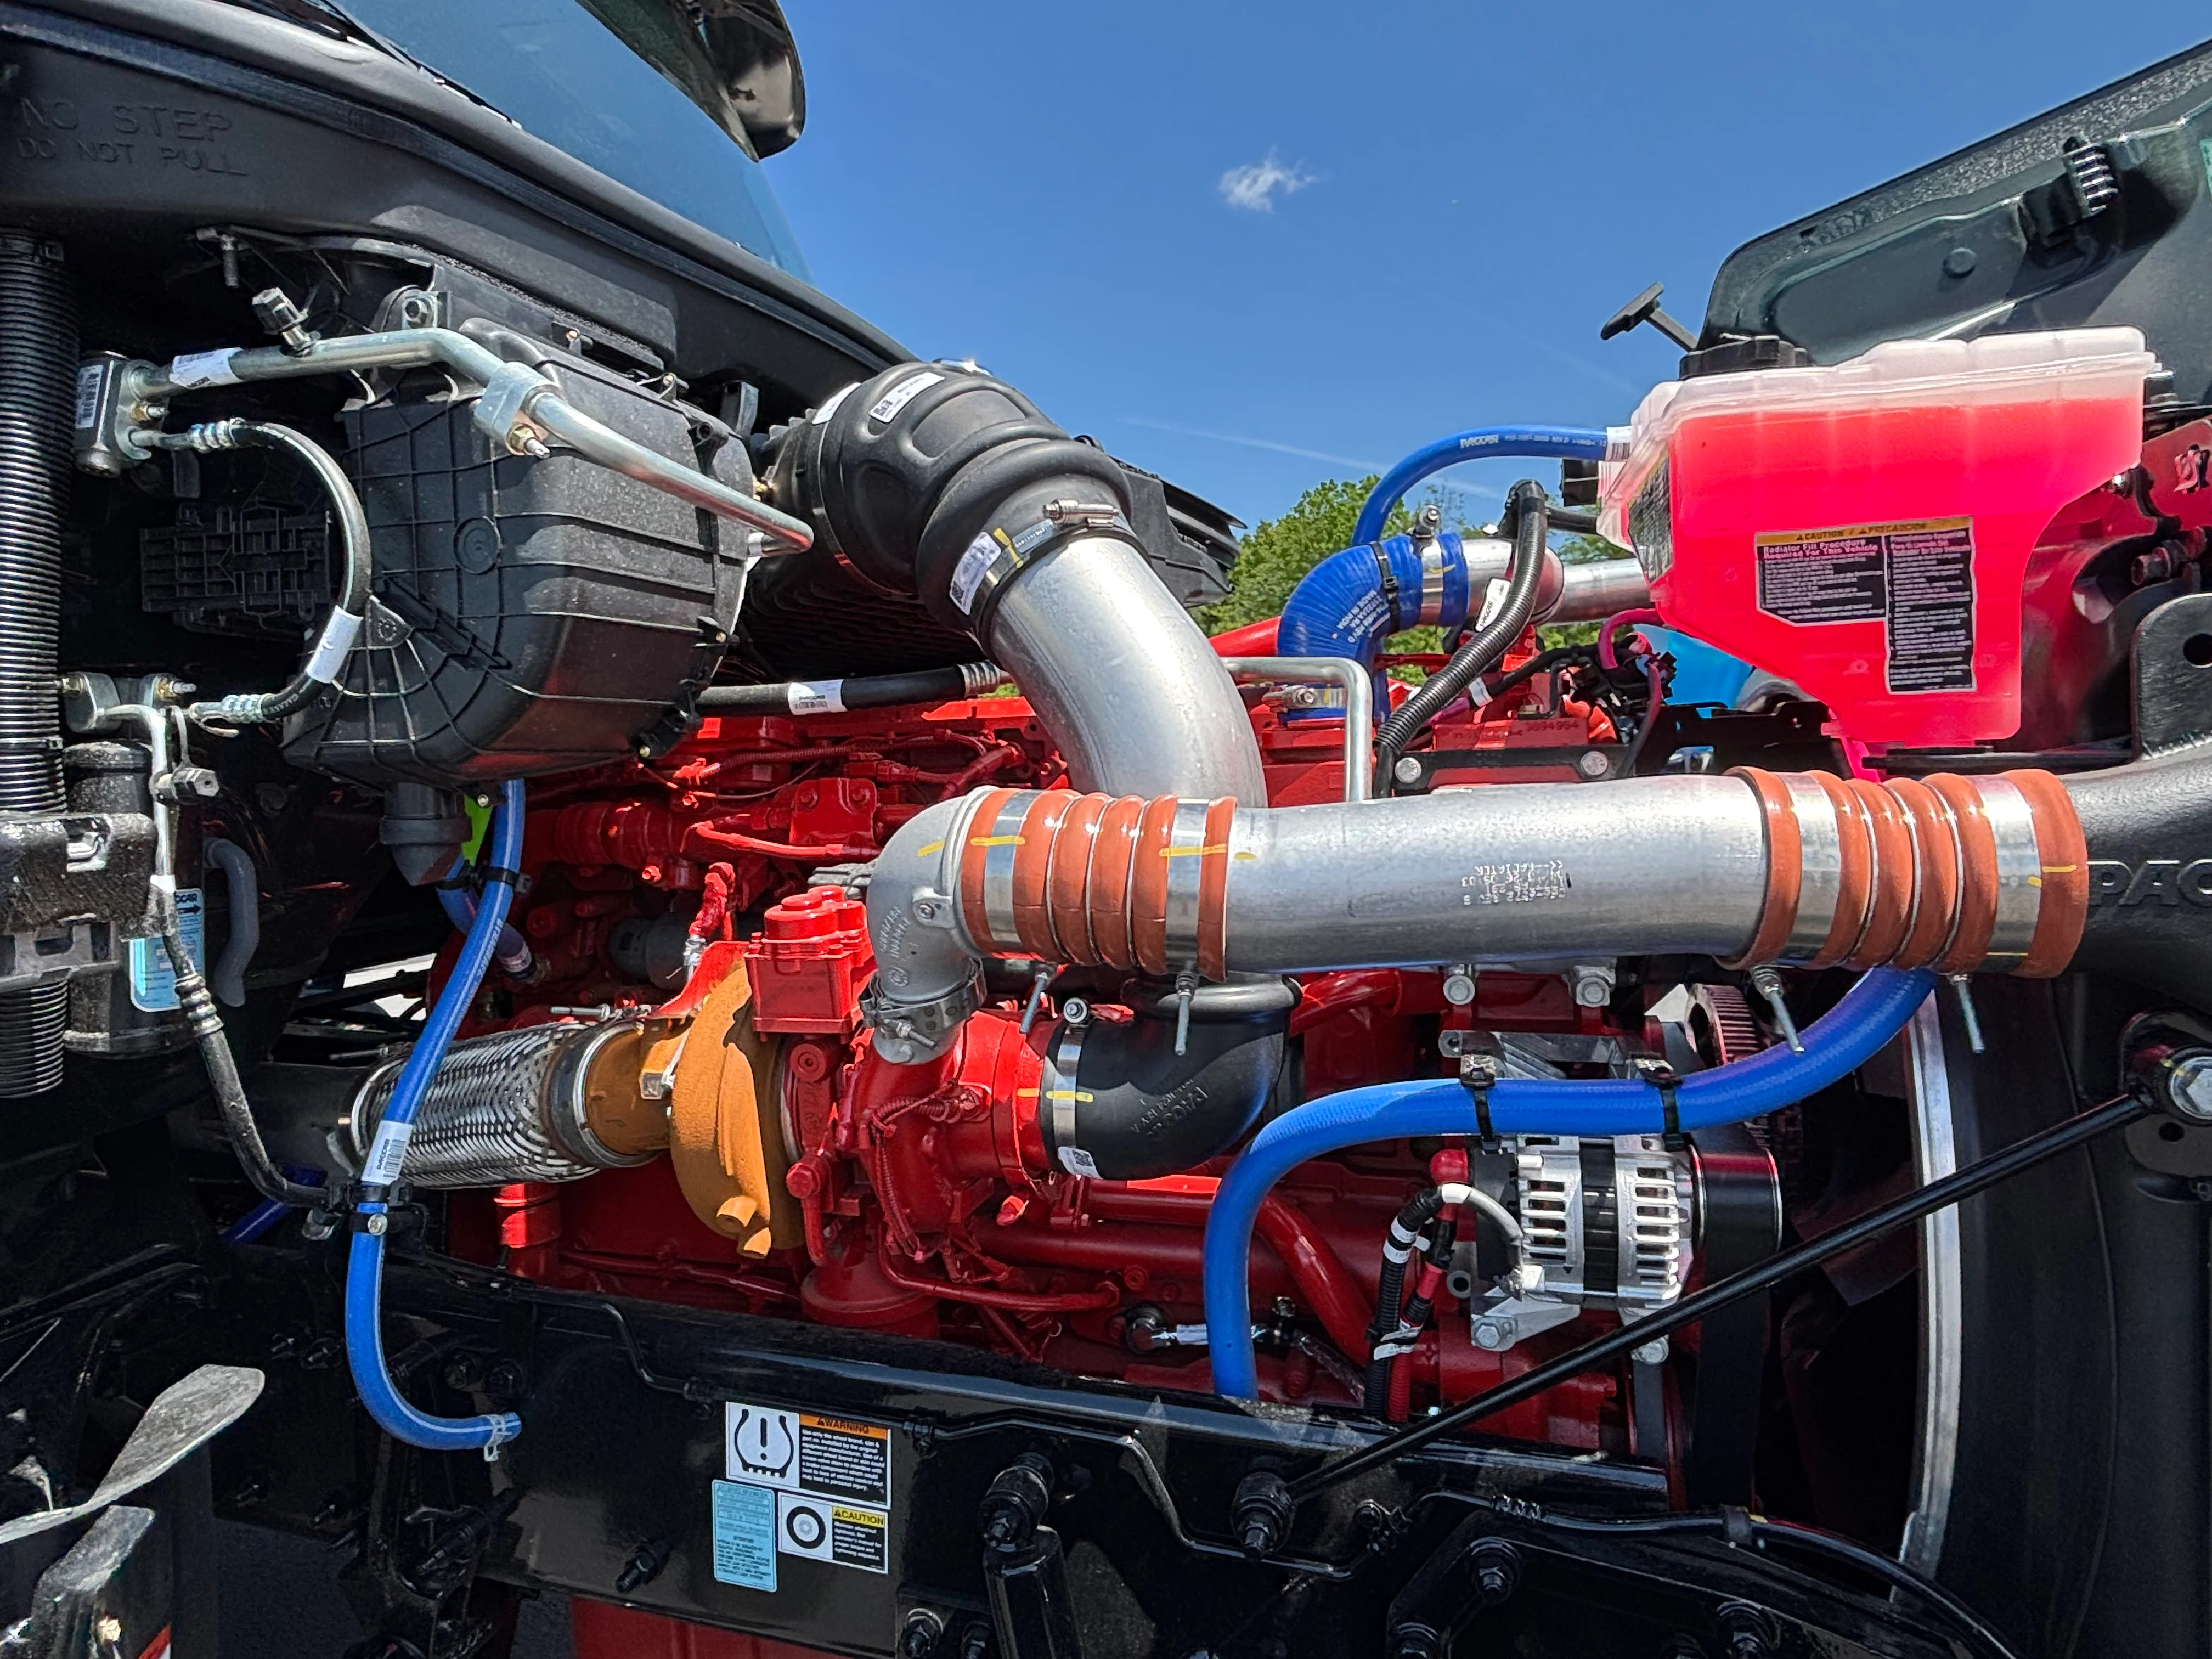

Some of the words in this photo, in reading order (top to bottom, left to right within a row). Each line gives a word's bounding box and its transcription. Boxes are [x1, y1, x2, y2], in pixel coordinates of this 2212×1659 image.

[20, 96, 79, 131] NO
[111, 105, 233, 142] STEP
[18, 138, 56, 160] DO
[77, 139, 134, 163] NOT
[160, 146, 248, 177] PULL
[1805, 530, 1844, 540] CAUTION
[1763, 545, 1801, 554] Radiator
[1819, 539, 1866, 549] Procedure
[1763, 550, 1804, 560] Required
[1844, 544, 1878, 552] Vehicle
[176, 893, 198, 903] CCAR
[825, 1417, 870, 1434] WARNING
[842, 1510, 883, 1525] CAUTION
